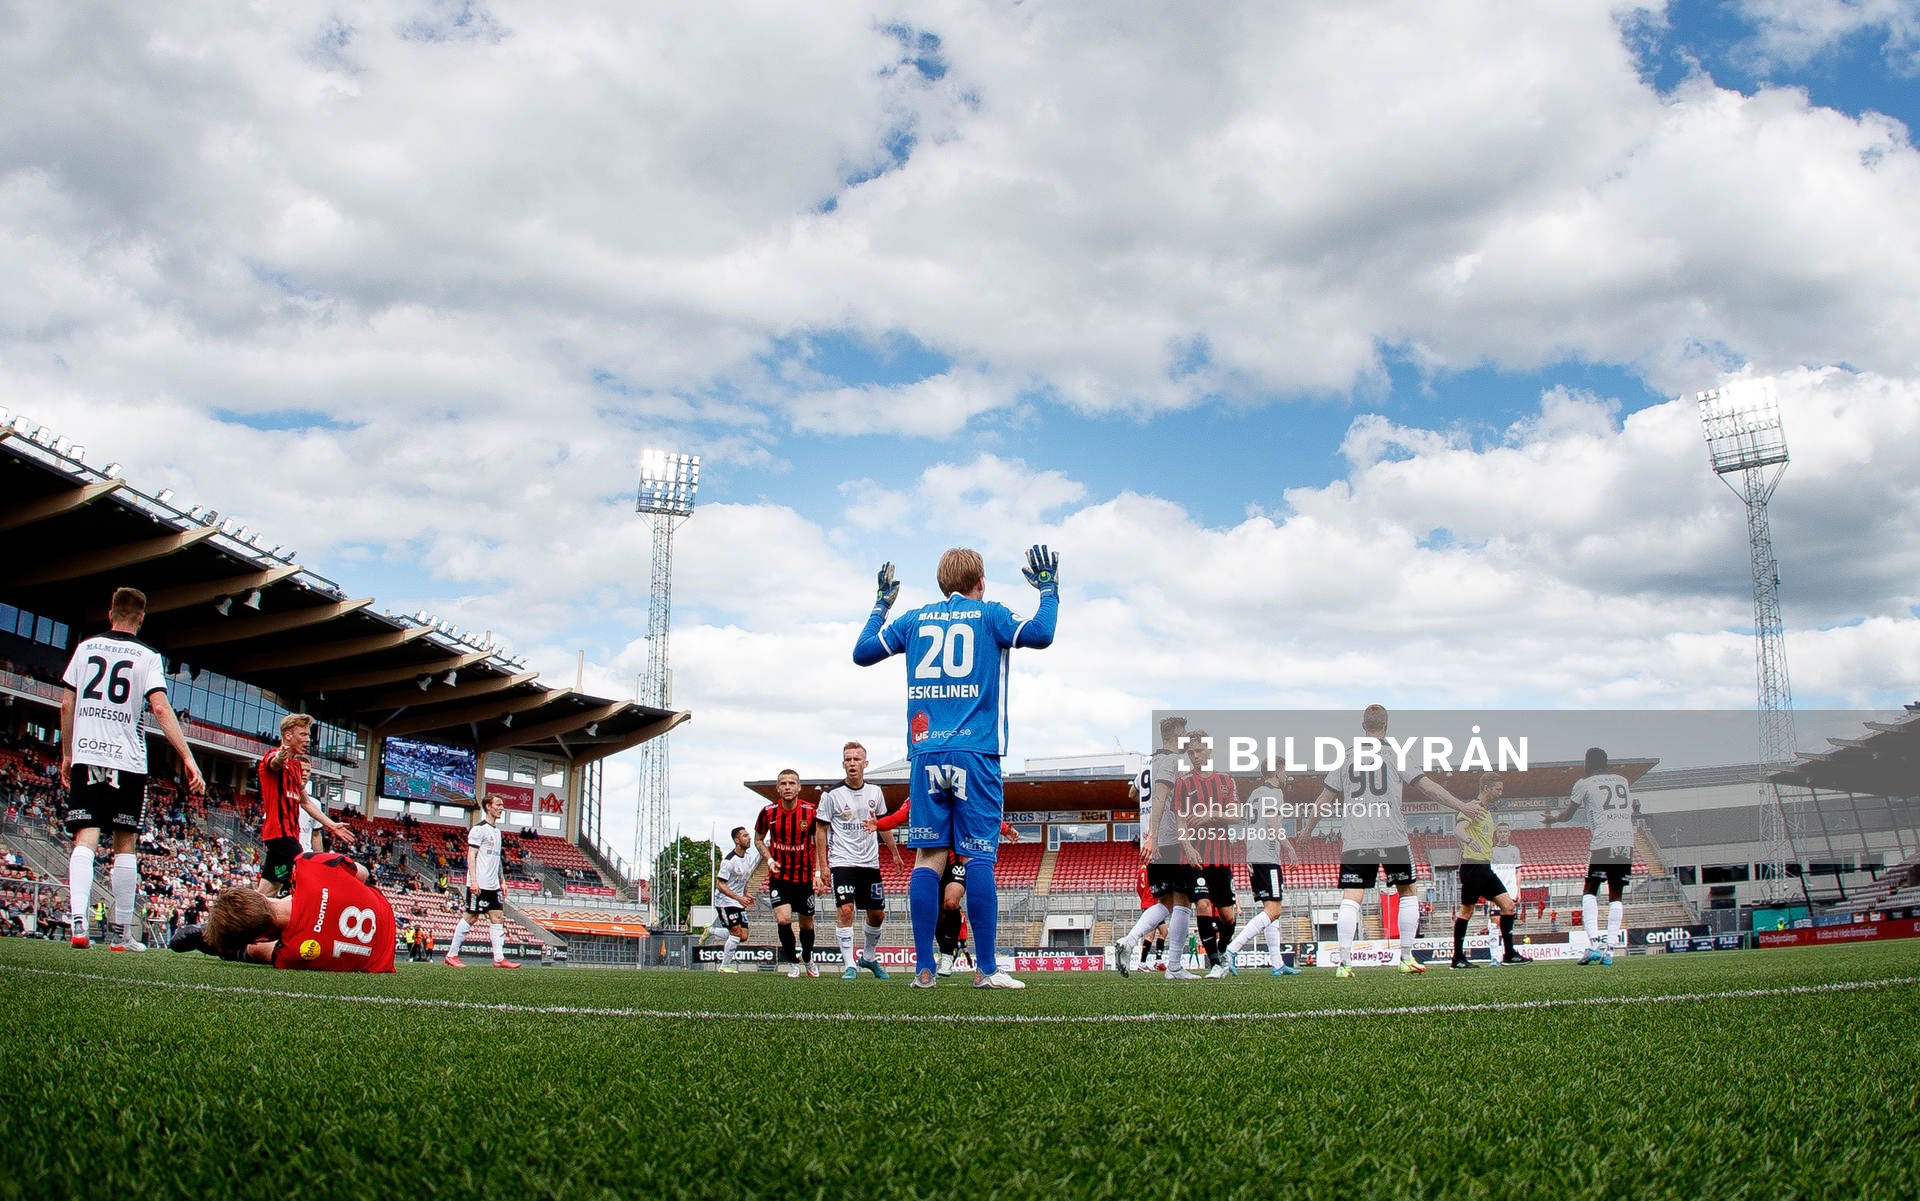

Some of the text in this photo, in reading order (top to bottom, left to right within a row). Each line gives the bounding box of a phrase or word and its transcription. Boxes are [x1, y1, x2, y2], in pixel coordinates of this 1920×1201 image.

[86, 643, 142, 656] MALMBERGS
[914, 623, 974, 679] 20
[82, 655, 134, 704] 26
[908, 684, 979, 699] ESKELINEN
[539, 792, 564, 815] MAX
[1598, 784, 1628, 811] 29
[1002, 811, 1035, 822] ERGS
[773, 842, 805, 852] BAUHAUS
[313, 888, 329, 933] Doorman
[332, 905, 377, 958] 18
[699, 949, 774, 961] tsream.se
[856, 948, 918, 964] Sandic
